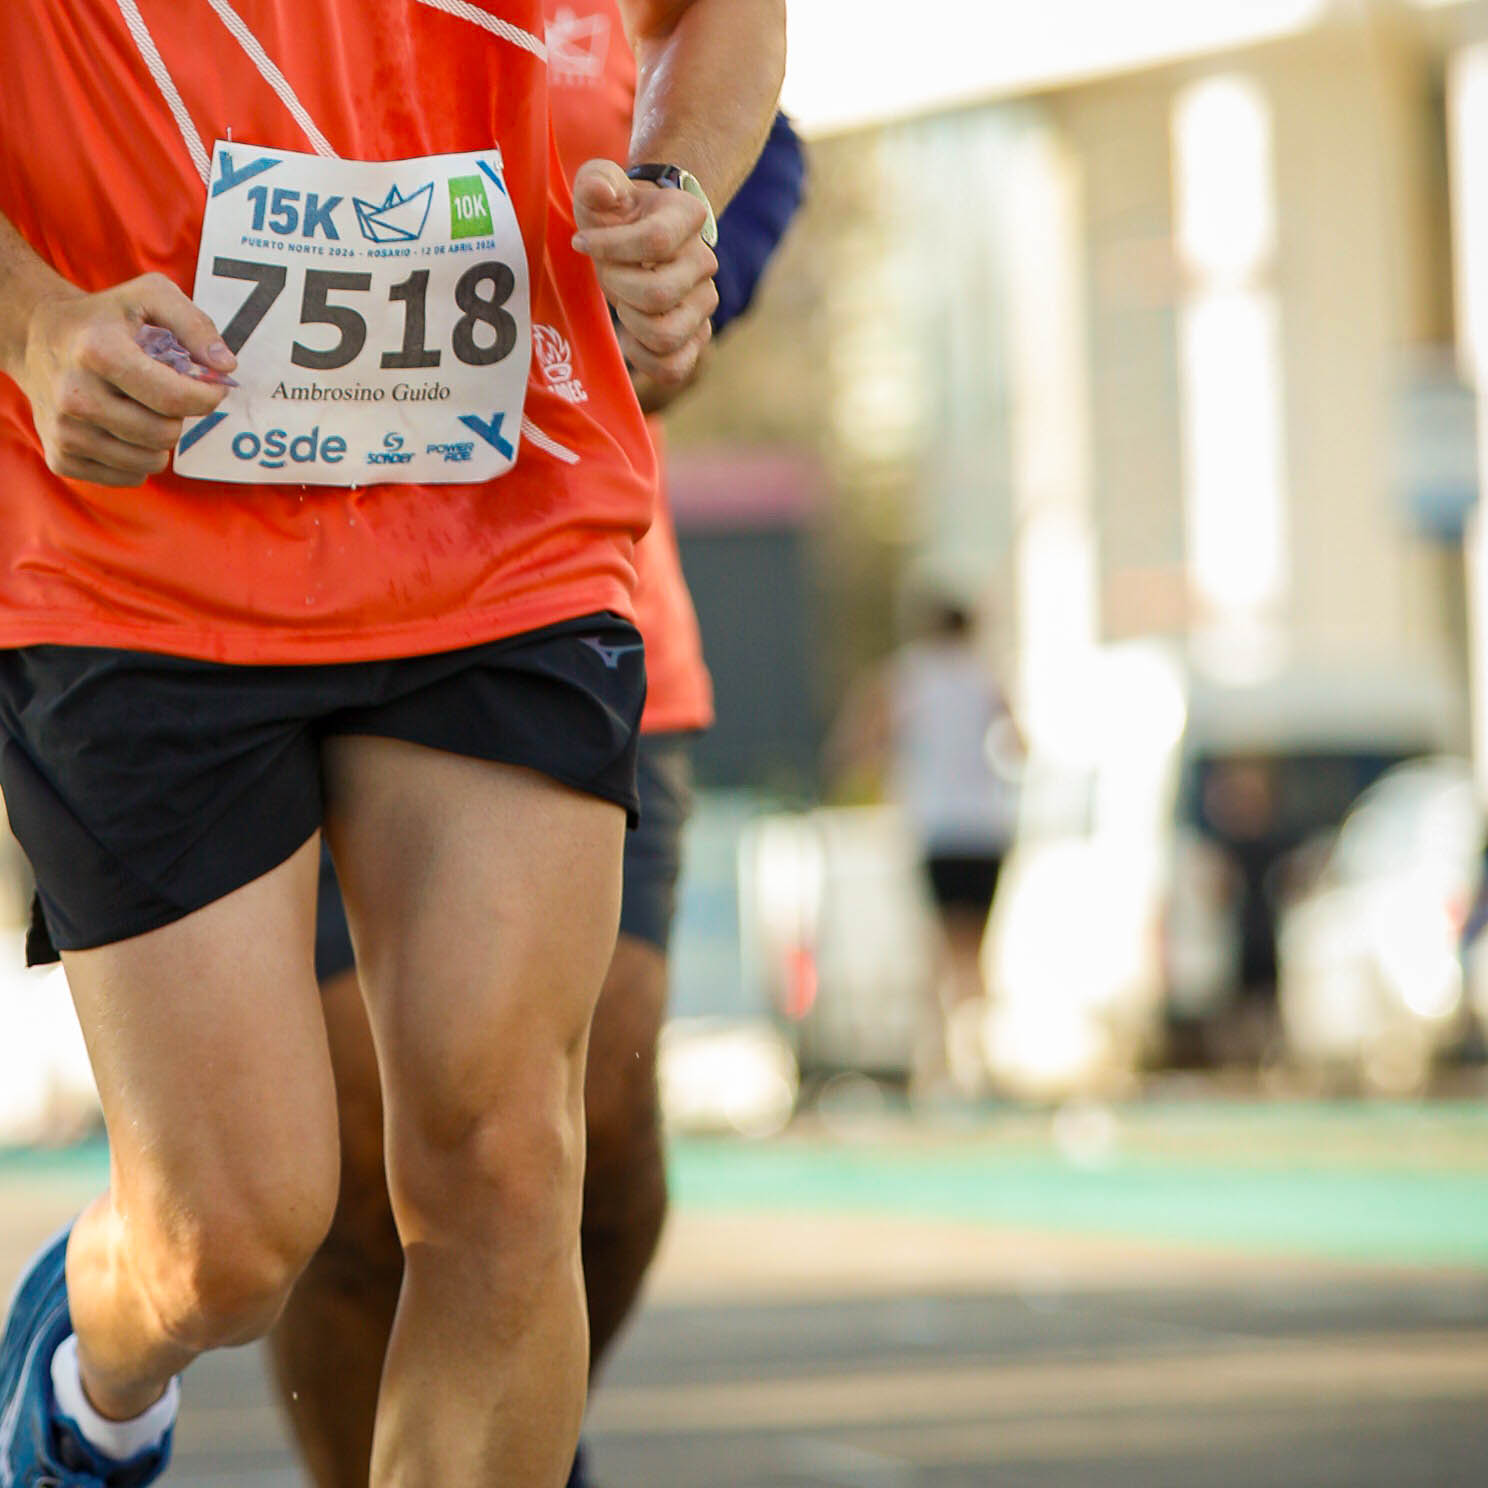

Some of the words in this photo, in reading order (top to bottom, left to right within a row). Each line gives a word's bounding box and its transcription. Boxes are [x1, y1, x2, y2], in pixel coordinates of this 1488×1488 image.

[247, 184, 344, 241] 15K
[454, 194, 487, 220] 10K
[241, 236, 284, 250] PUERTO
[288, 243, 324, 256] NORTE
[367, 247, 411, 258] ROSARIO
[421, 247, 431, 256] 12
[434, 245, 446, 255] DE
[448, 243, 473, 254] ABRIL
[212, 255, 518, 370] 7518
[271, 381, 385, 402] Ambrosino
[392, 382, 451, 402] Guido
[231, 425, 348, 466] osde
[426, 442, 475, 455] POWER
